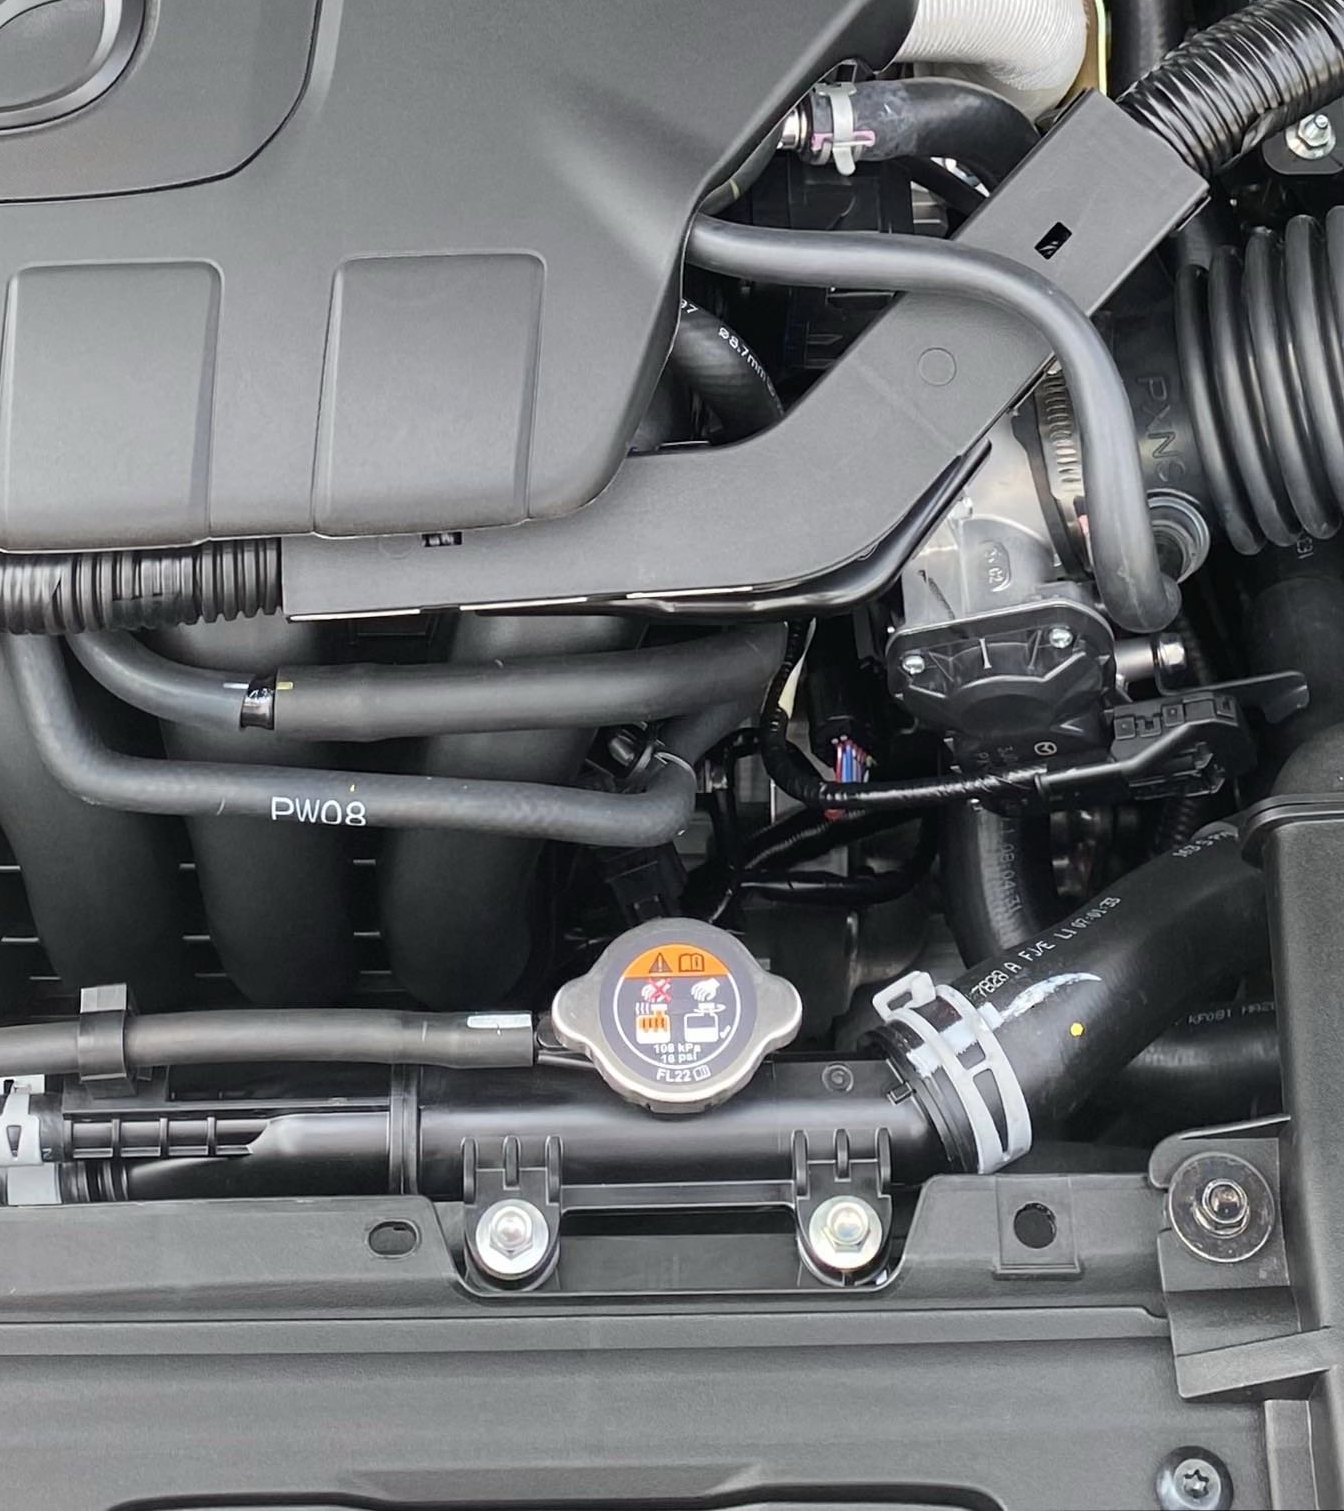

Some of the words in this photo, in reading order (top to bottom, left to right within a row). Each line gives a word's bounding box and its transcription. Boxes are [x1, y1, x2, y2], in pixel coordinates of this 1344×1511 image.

[270, 795, 367, 827] PW08
[677, 1042, 702, 1055] kPa
[656, 1068, 693, 1082] FL22
